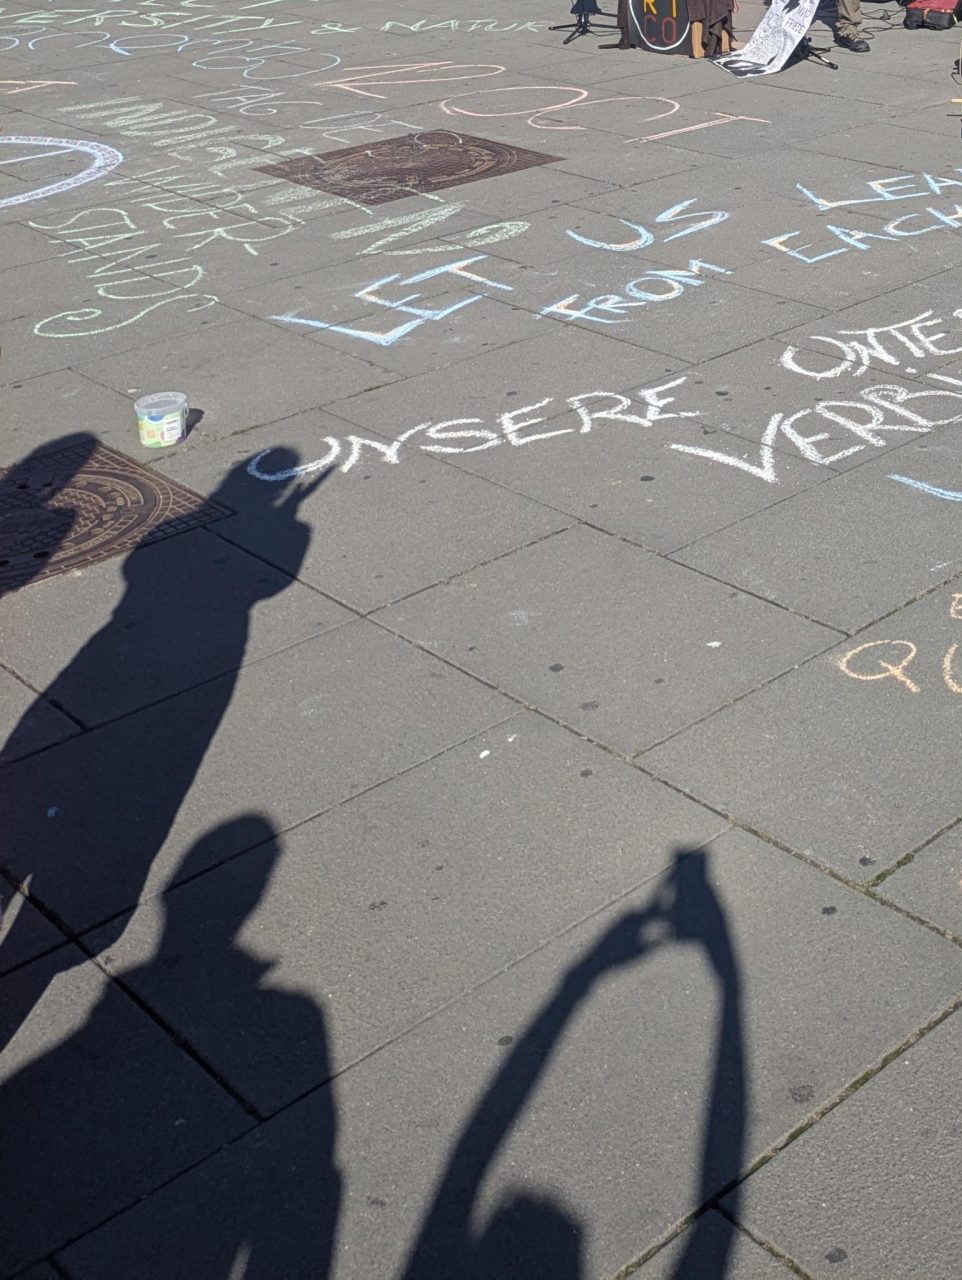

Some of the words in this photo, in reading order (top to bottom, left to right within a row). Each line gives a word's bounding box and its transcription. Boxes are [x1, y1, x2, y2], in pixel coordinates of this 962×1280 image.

[192, 84, 322, 116] TAG
[28, 207, 219, 337] STANDS
[271, 254, 513, 346] LET
[566, 198, 730, 251] US
[534, 258, 734, 323] FROM
[247, 375, 701, 482] UNSERE
